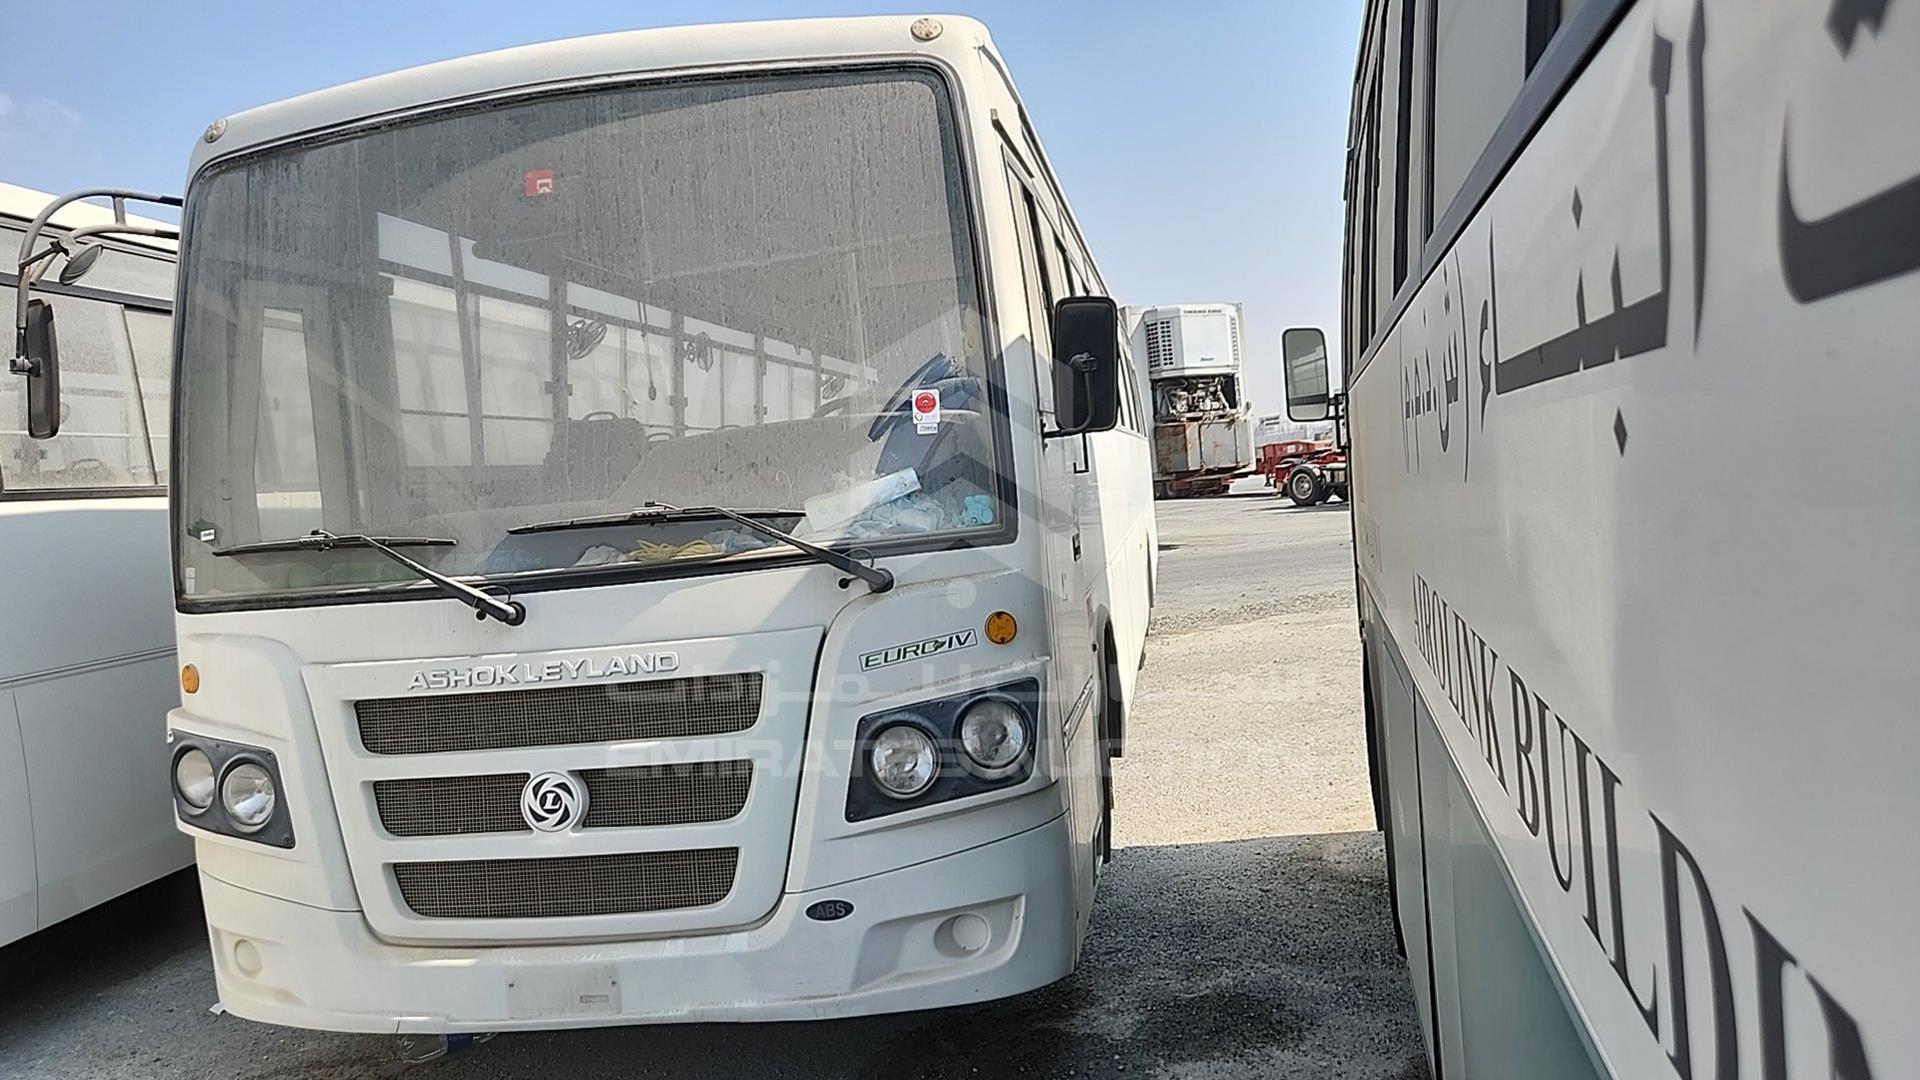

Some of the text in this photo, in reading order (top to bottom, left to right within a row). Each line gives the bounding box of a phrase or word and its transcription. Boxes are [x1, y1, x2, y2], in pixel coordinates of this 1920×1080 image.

[407, 651, 681, 690] ASHOK LEYLAND
[543, 792, 562, 810] L
[1411, 568, 1873, 1080] AIROLINK BUILDI
[815, 903, 846, 919] ABS
